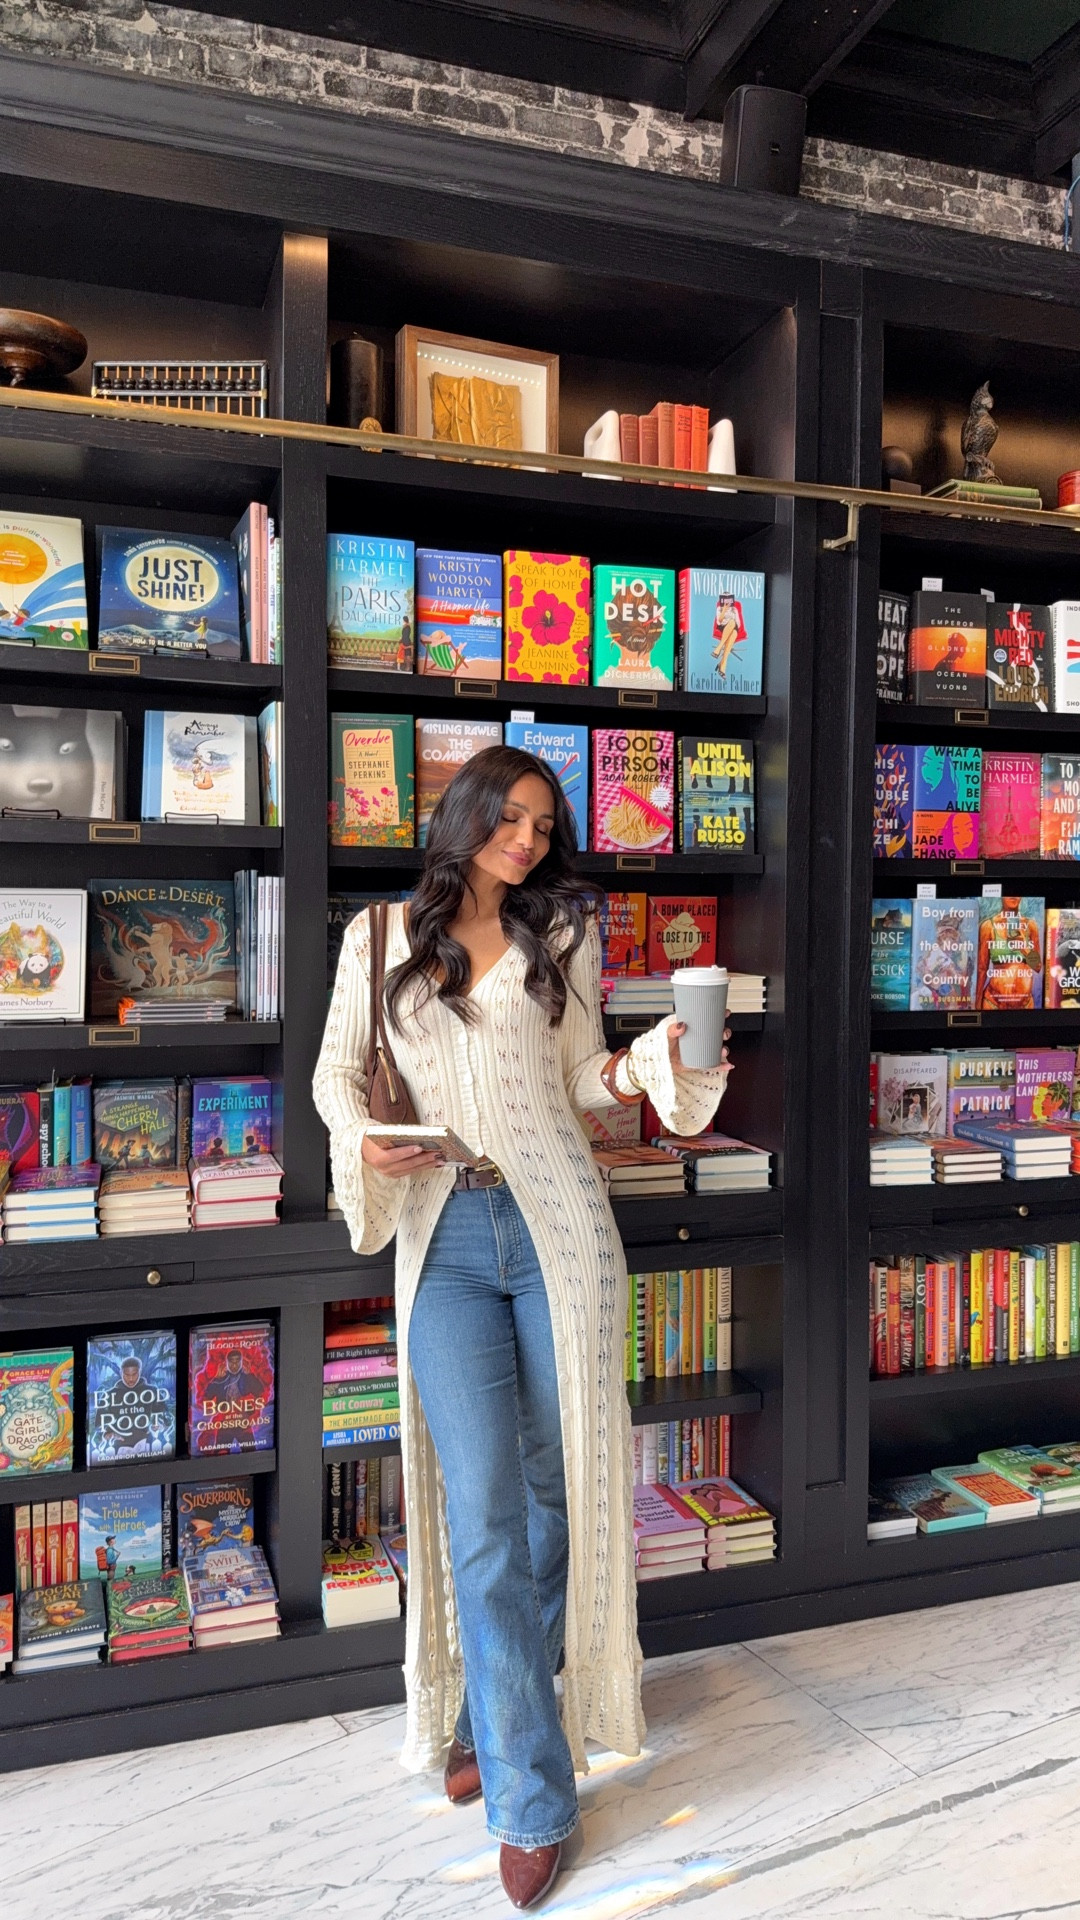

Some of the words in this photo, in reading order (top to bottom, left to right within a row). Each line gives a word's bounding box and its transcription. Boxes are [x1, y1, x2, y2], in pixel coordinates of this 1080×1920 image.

[336, 540, 406, 560] KRISTIN
[139, 556, 203, 583] JUST
[335, 558, 406, 577] HARMEL
[440, 560, 481, 574] KRISTY
[515, 564, 547, 576] SPEAK
[551, 567, 566, 578] TO
[568, 568, 584, 579] ME
[362, 576, 378, 587] THE
[428, 572, 492, 587] WOODSON
[525, 577, 539, 588] OF
[543, 579, 577, 591] HOME
[693, 571, 763, 599] WORKHORSE
[137, 580, 205, 602] SHINE!
[437, 586, 483, 599] HARVEY
[611, 577, 662, 599] HOT
[341, 585, 402, 612] PARIS
[430, 600, 438, 612] A
[440, 600, 473, 613] Happier
[474, 599, 491, 615] Life
[604, 601, 668, 625] DESK
[341, 610, 401, 626] DAUGHTER
[1007, 611, 1033, 629] THE
[994, 628, 1047, 649] MIGHTY
[527, 648, 570, 660] JEANINE
[1008, 647, 1034, 666] RED
[521, 659, 576, 673] CUMMINS
[618, 657, 652, 668] LAURA
[604, 669, 666, 681] DICKERMAN
[998, 665, 1045, 685] LOUISE
[690, 672, 728, 691] Caroline
[730, 675, 760, 693] Palmer
[995, 684, 1049, 704] ERDRICH
[184, 726, 226, 736] Remember
[422, 723, 462, 736] AISLING
[464, 725, 499, 737] RAWLE
[344, 730, 391, 747] Overdue
[448, 738, 473, 750] THE
[524, 731, 575, 747] Edward
[608, 736, 664, 753] FOOD
[538, 749, 581, 765] Aubyn
[697, 742, 745, 760] UNTIL
[933, 746, 969, 758] WHAT
[972, 748, 981, 758] A
[348, 760, 390, 770] STEPHANIE
[602, 756, 670, 772] PERSON
[690, 760, 751, 778] ALISON
[952, 761, 981, 772] TIME
[985, 761, 1034, 772] KRISTIN
[1060, 763, 1074, 779] TO
[354, 770, 386, 778] PERKINS
[603, 774, 630, 782] ADAM
[632, 774, 669, 782] ROBERTS
[889, 775, 906, 785] OF
[965, 774, 980, 785] TO
[983, 772, 1036, 785] HARMEL
[966, 788, 980, 798] BE
[946, 801, 979, 812] ALIVE
[1053, 798, 1075, 814] AND
[702, 815, 740, 830] KATE
[697, 829, 745, 844] RUSSO
[914, 835, 944, 846] JADE
[912, 849, 957, 859] CHANG
[101, 888, 156, 906] DANCE
[169, 886, 226, 907] DESERT
[2, 902, 16, 910] The
[19, 900, 36, 908] Way
[606, 900, 638, 911] Train
[661, 904, 684, 916] BOMB
[687, 904, 716, 916] PLACED
[37, 910, 67, 930] World
[922, 907, 946, 920] Boy
[949, 907, 975, 918] from
[603, 925, 638, 936] Three
[994, 922, 1028, 932] MOTTLEY
[656, 932, 680, 944] CLOSE
[683, 932, 693, 943] TO
[697, 932, 711, 944] THE
[919, 941, 939, 952] the
[943, 941, 974, 952] North
[987, 941, 1006, 950] THE
[1008, 941, 1034, 950] GIRLS
[669, 958, 696, 968] HEART
[998, 955, 1022, 964] WHO
[872, 964, 906, 976] ESICK
[986, 969, 1016, 978] GREW
[1018, 969, 1033, 978] BIG
[922, 974, 969, 987] Country
[20, 998, 54, 1008] Norbury
[959, 1061, 1013, 1077] BUCKEYE
[1018, 1059, 1039, 1070] THIS
[1016, 1071, 1073, 1084] MOTHERLESS
[1016, 1085, 1039, 1097] LAND
[198, 1095, 269, 1112] EXPERIMENT
[960, 1095, 1011, 1112] PATRICK
[116, 1108, 159, 1131] CHERRY
[607, 1105, 631, 1120] Beach
[140, 1117, 169, 1135] HALL
[616, 1117, 638, 1129] House
[40, 1123, 48, 1141] spy
[614, 1129, 636, 1140] Rules
[916, 1273, 925, 1306] BOY
[206, 1342, 234, 1350] BLOOD
[240, 1340, 262, 1349] ROOT
[346, 1349, 362, 1358] Right
[371, 1381, 397, 1391] BOMBAY
[94, 1388, 170, 1409] BLOOD
[332, 1401, 346, 1412] Kit
[348, 1398, 384, 1410] Conway
[130, 1406, 144, 1414] the
[203, 1397, 265, 1416] BONES
[100, 1412, 164, 1436] ROOT
[197, 1416, 270, 1432] CROSSROADS
[342, 1414, 382, 1426] HOMEMADE
[7, 1431, 52, 1445] DRAGON
[353, 1428, 386, 1443] LOVED
[239, 1440, 267, 1448] WILLIAMS
[137, 1450, 166, 1458] WILLIAMS
[180, 1488, 251, 1513] SILVERBORN
[102, 1507, 138, 1520] Trouble
[113, 1520, 147, 1533] Heroes
[322, 1558, 389, 1574] Sloppy
[326, 1580, 356, 1590] Rax
[358, 1574, 395, 1585] King
[35, 1582, 90, 1600] POCKET
[43, 1591, 82, 1605] BEAR
[28, 1631, 62, 1642] KATHERINE
[65, 1624, 100, 1634] APPLEGATE
